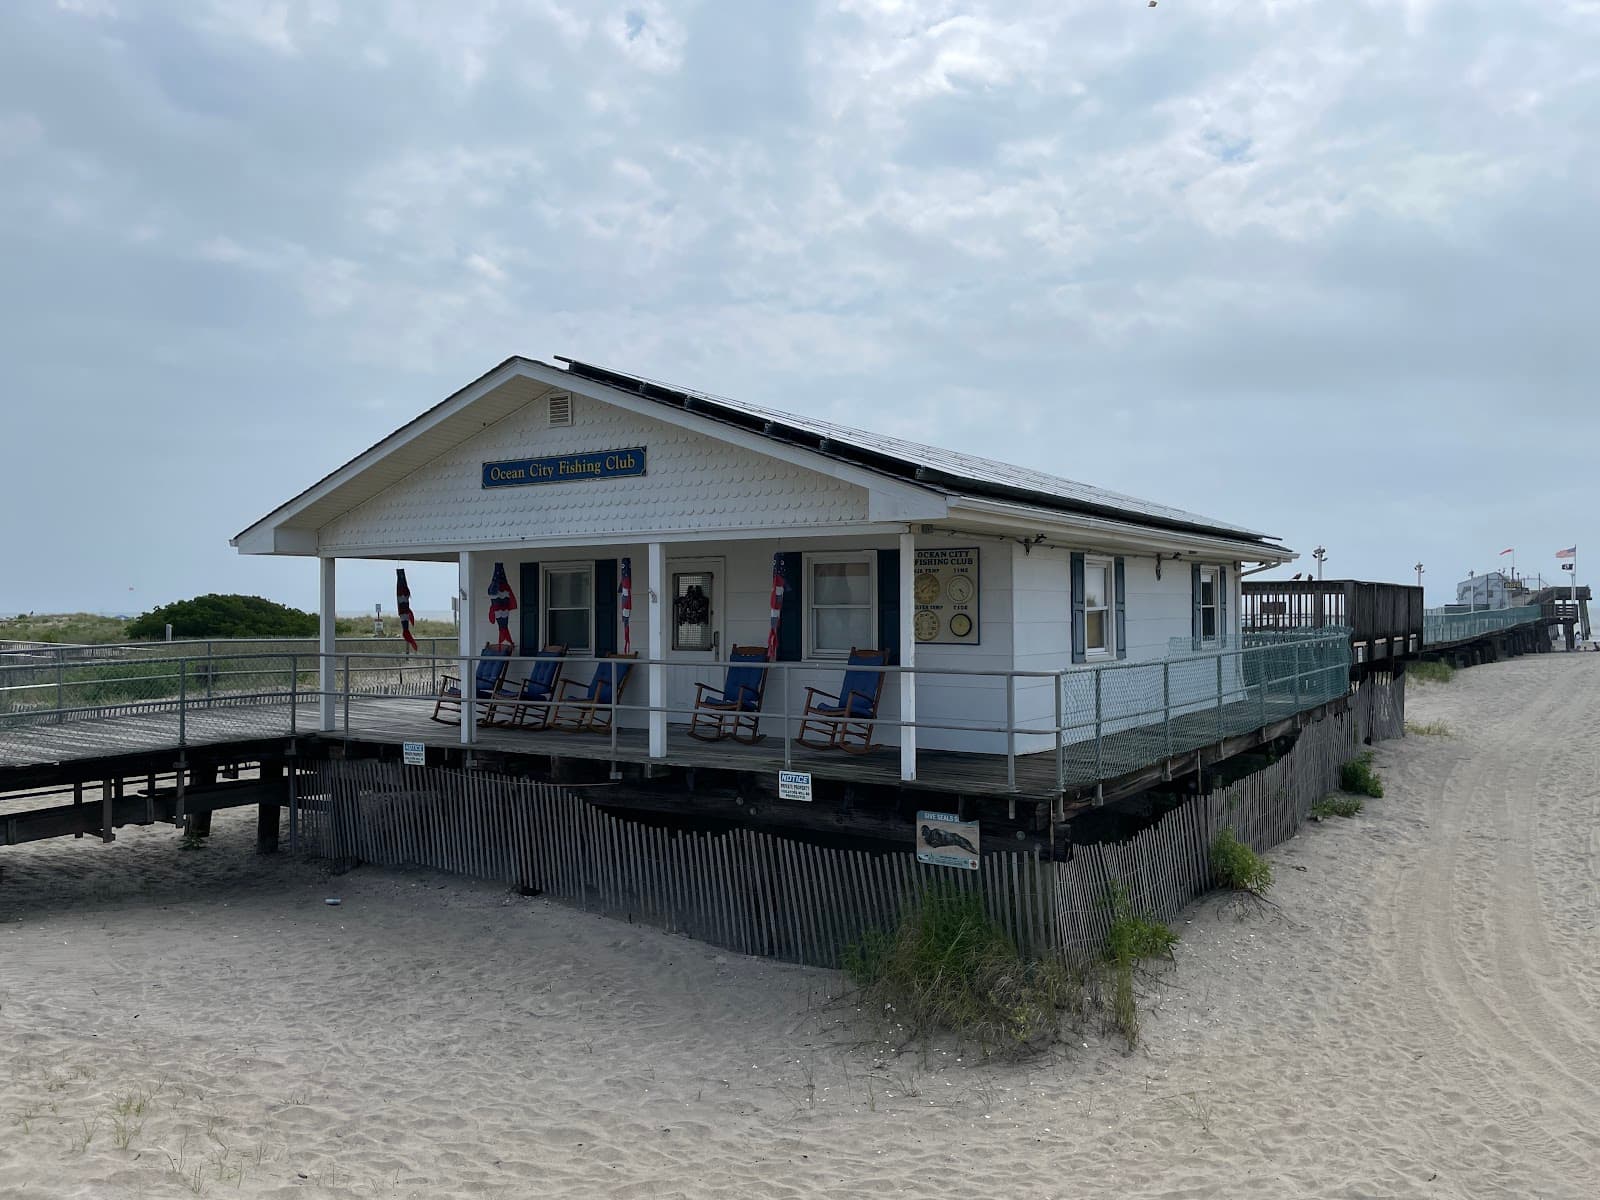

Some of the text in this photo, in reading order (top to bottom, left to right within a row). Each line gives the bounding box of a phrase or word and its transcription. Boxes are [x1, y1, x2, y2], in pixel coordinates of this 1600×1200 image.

[490, 454, 636, 481] Ocean City Fishing Club
[917, 550, 970, 559] OCEAN CITY
[914, 557, 974, 566] FISHING CLUB
[781, 774, 809, 784] NOTICE
